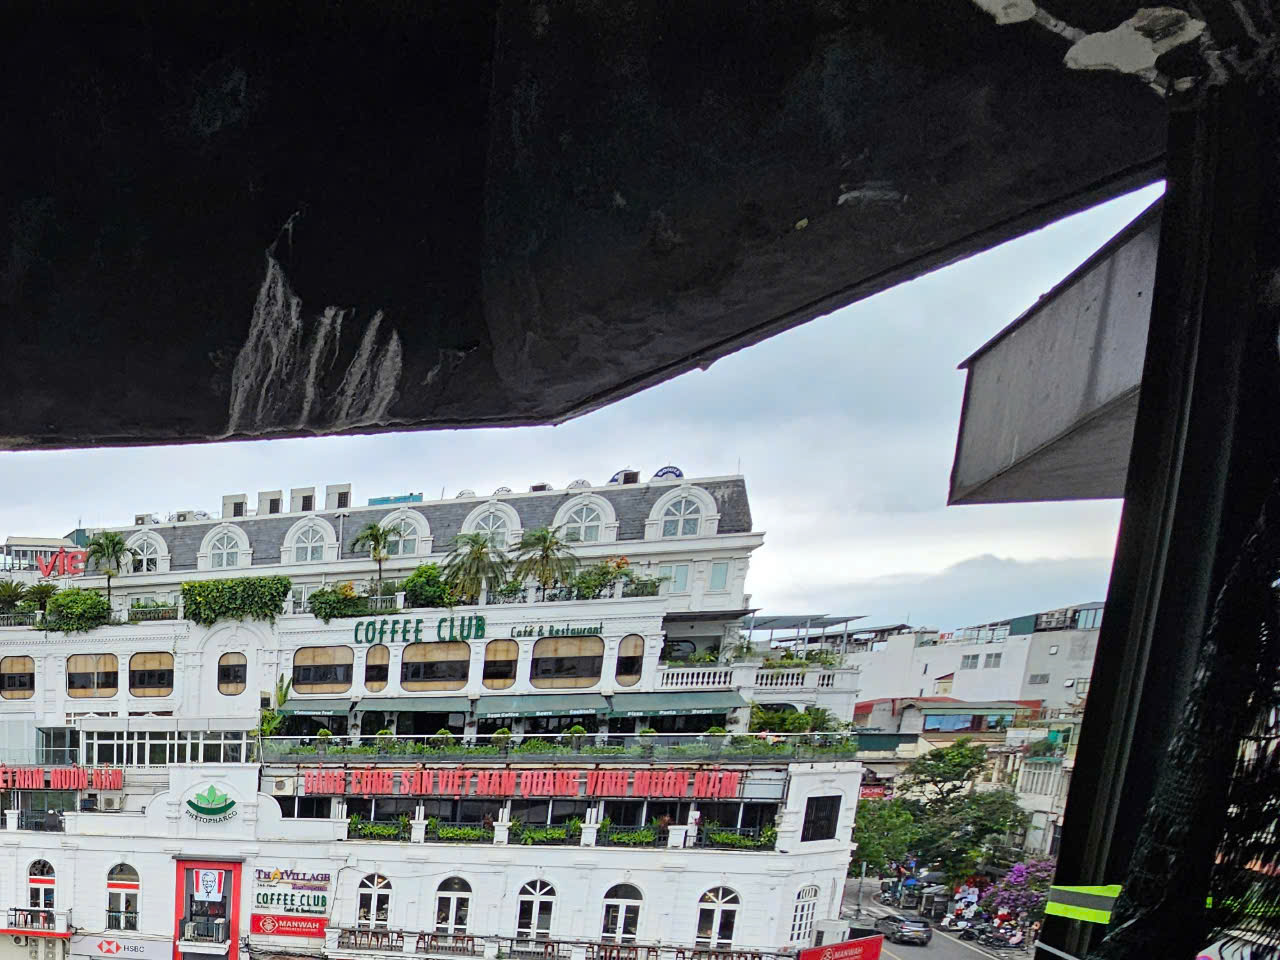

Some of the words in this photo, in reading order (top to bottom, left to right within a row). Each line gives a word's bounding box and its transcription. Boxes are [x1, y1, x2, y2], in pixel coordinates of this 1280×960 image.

[354, 618, 424, 644] COFFEE
[437, 615, 486, 642] CLUB
[538, 625, 545, 637] &
[549, 621, 604, 637] Restaurant
[16, 768, 44, 789] NAM
[438, 764, 473, 799] VIỆT
[477, 770, 516, 796] NAM
[520, 770, 579, 798] QUANG
[586, 770, 628, 796] VINH
[185, 809, 238, 823] PHYTOPHARCO
[256, 892, 295, 906] COFFEE
[300, 894, 327, 908] CLUB
[278, 920, 319, 929] MANWAH
[123, 945, 145, 953] HSBC
